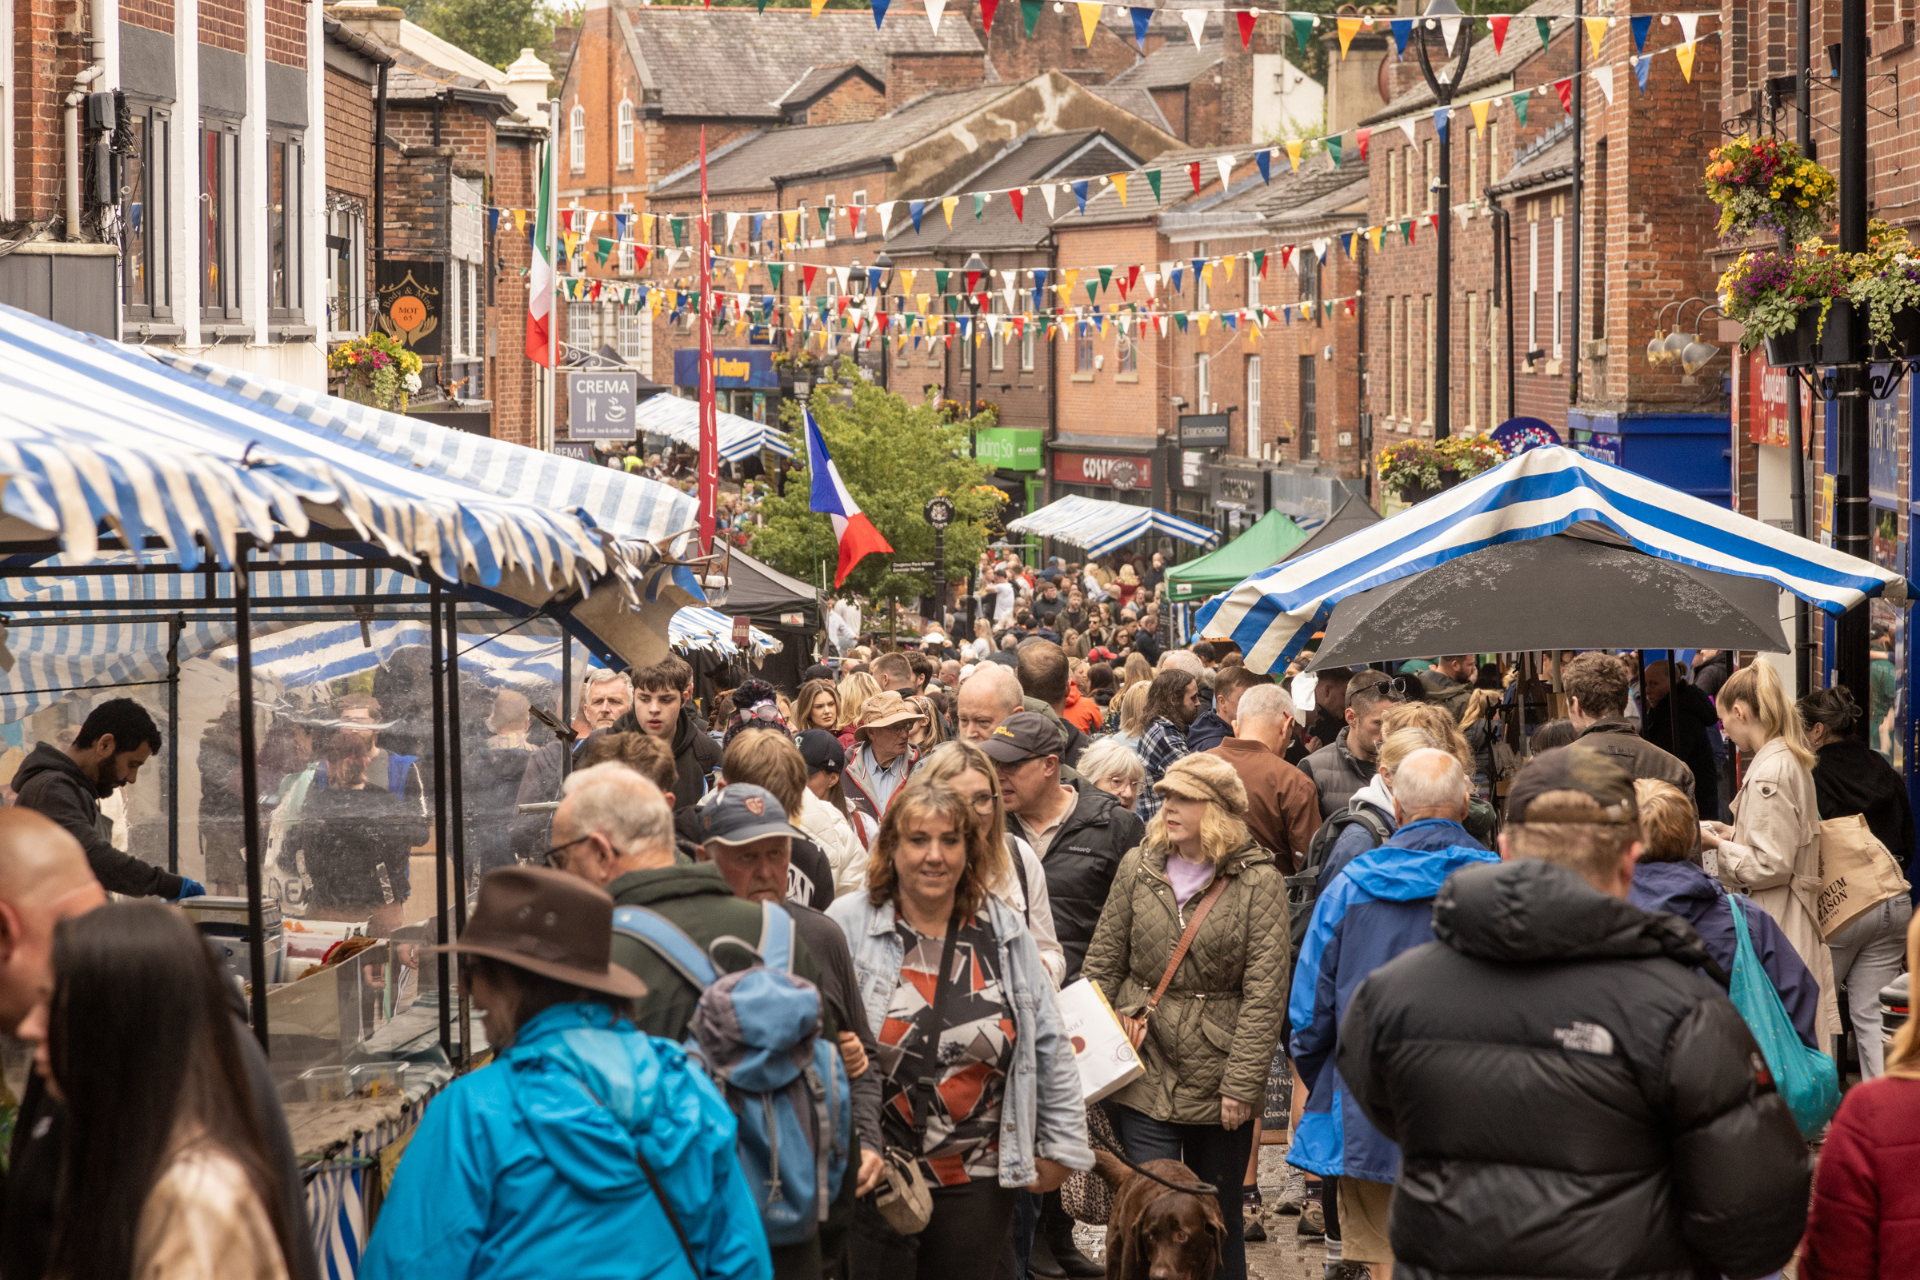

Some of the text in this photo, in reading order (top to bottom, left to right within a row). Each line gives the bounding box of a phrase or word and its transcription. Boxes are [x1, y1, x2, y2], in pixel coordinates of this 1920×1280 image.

[382, 286, 434, 310] Body & Mind
[398, 306, 419, 314] MOT
[720, 358, 750, 382] Factory
[576, 379, 630, 394] CREMA
[554, 446, 584, 459] REMA
[976, 437, 1000, 462] uilding
[1114, 461, 1134, 472] COSTA
[1114, 476, 1138, 488] COFFEE
[926, 497, 954, 509] CONGLETON
